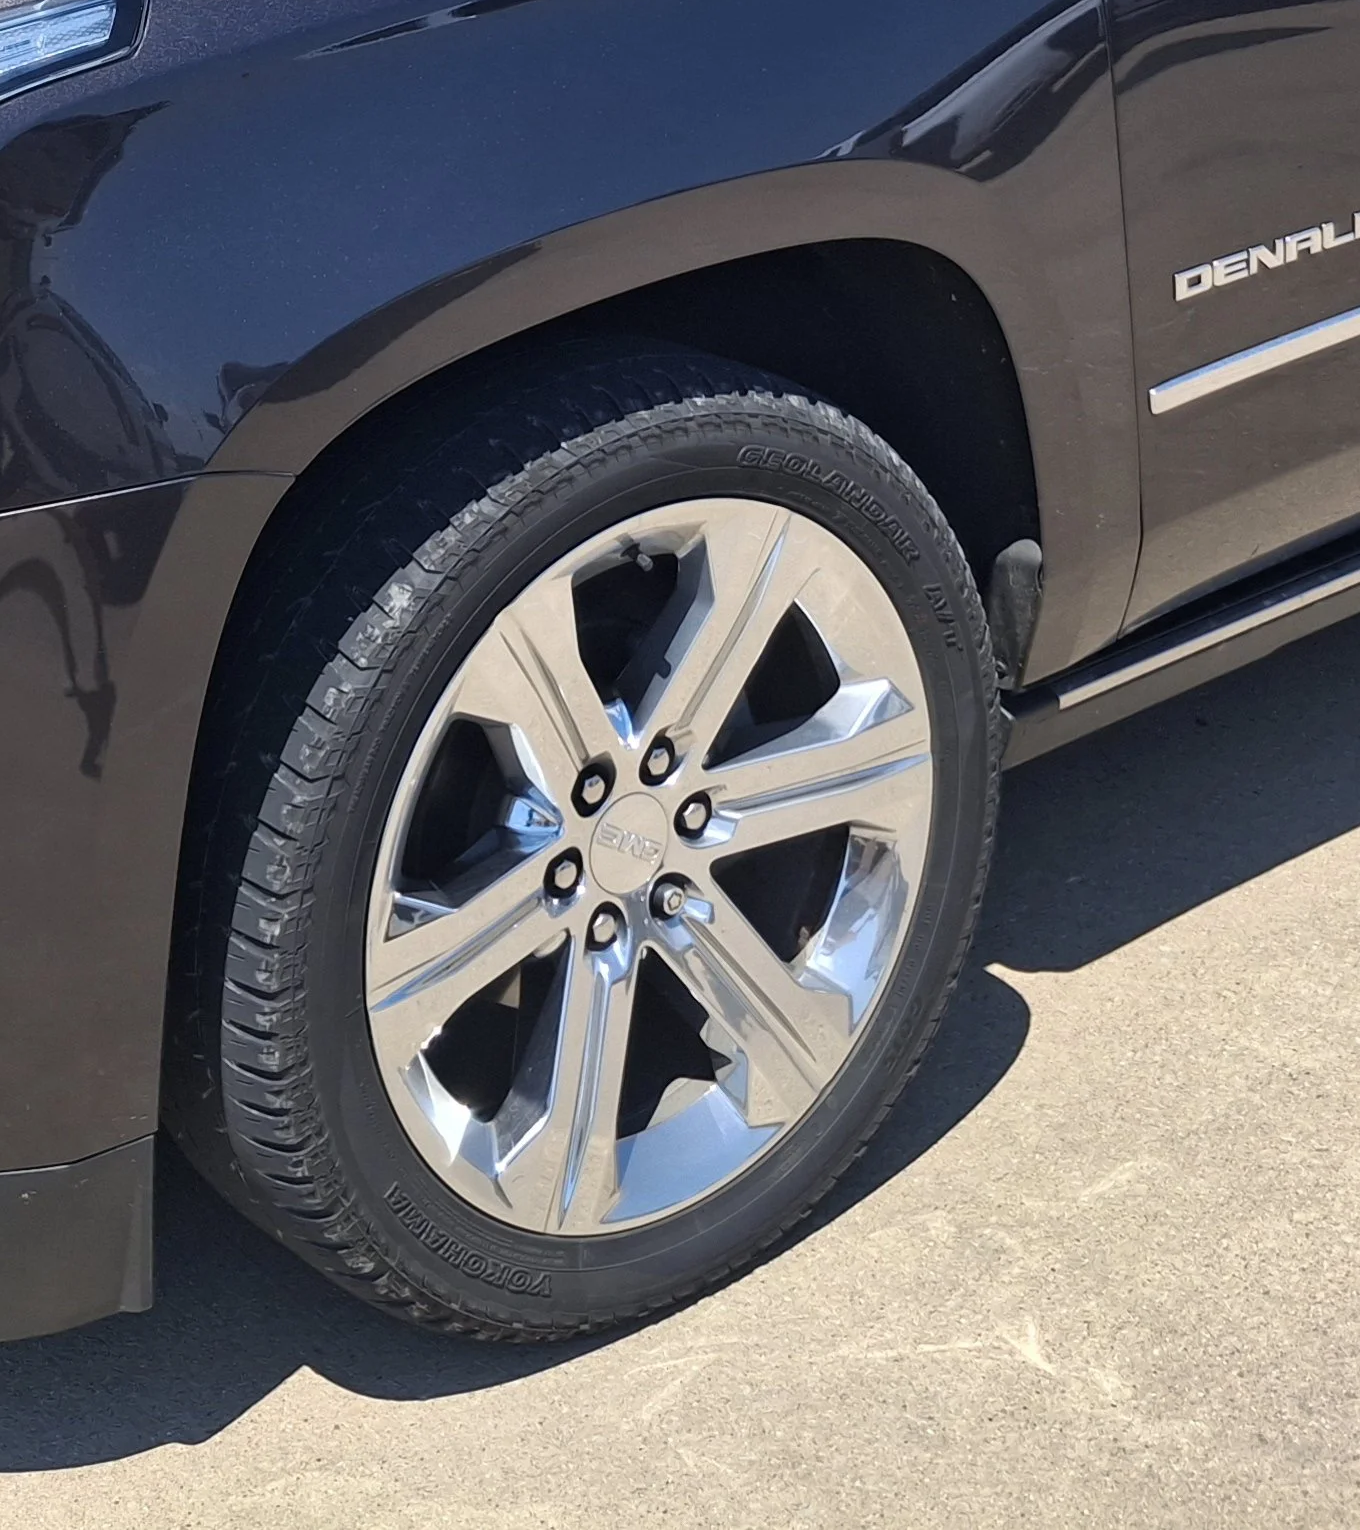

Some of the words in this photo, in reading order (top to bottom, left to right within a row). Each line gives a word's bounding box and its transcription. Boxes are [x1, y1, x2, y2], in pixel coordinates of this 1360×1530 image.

[736, 444, 922, 567] GEOLANDAR
[596, 821, 662, 864] GMC
[383, 1180, 554, 1298] YOKOHAMA
